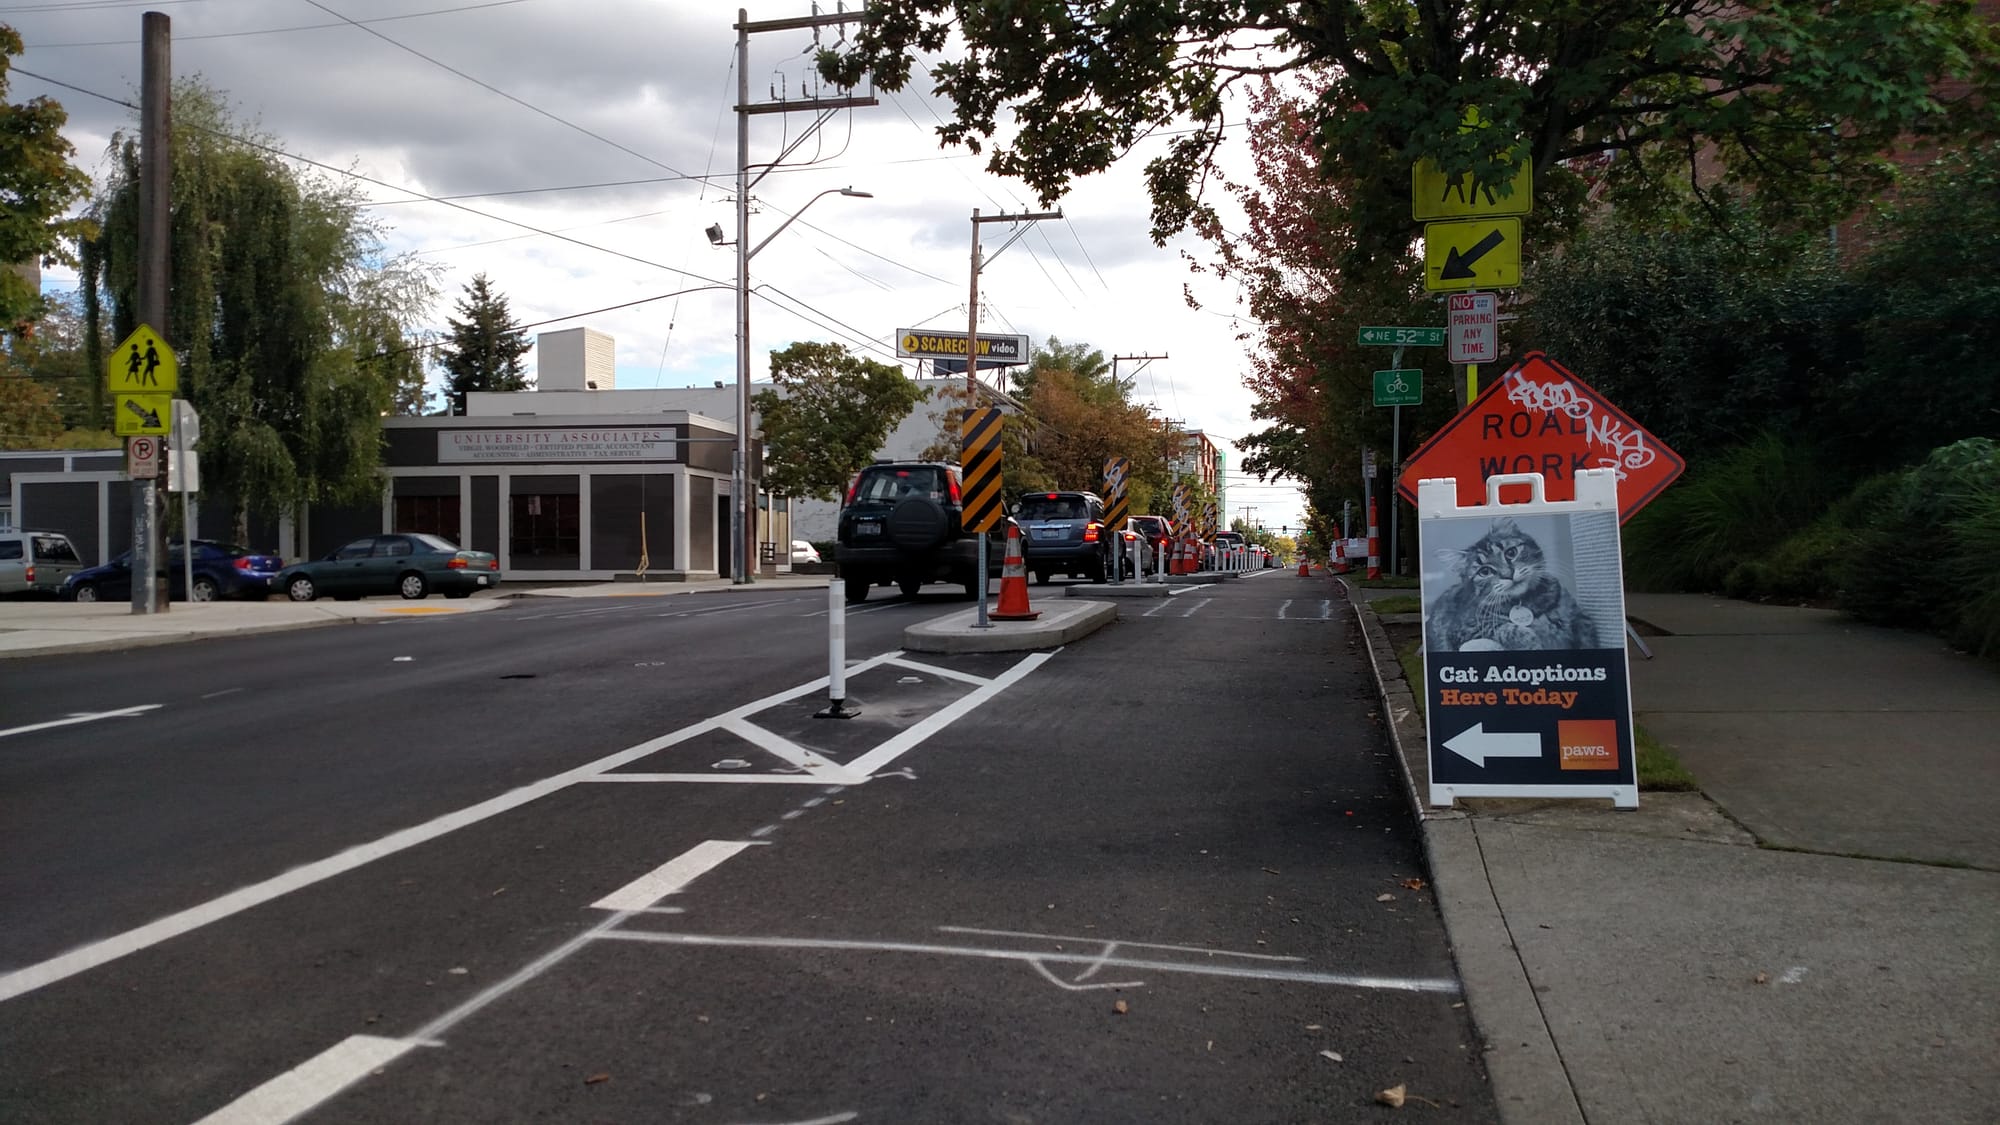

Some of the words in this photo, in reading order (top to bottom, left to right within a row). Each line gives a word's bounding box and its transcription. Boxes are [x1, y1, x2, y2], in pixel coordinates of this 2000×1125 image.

[1452, 296, 1470, 309] NO
[1453, 313, 1492, 326] PARKING
[1376, 331, 1391, 341] NE
[1429, 332, 1440, 342] St
[1463, 328, 1482, 340] ANY
[1462, 342, 1485, 354] TIME
[454, 433, 551, 444] UNIVERSITY
[560, 432, 661, 442] ASSOCIATES
[1439, 666, 1479, 683] Cat
[1483, 664, 1607, 685] Adoptions
[1440, 689, 1498, 706] Here
[1502, 688, 1578, 709] Today
[1562, 745, 1610, 760] paws.
